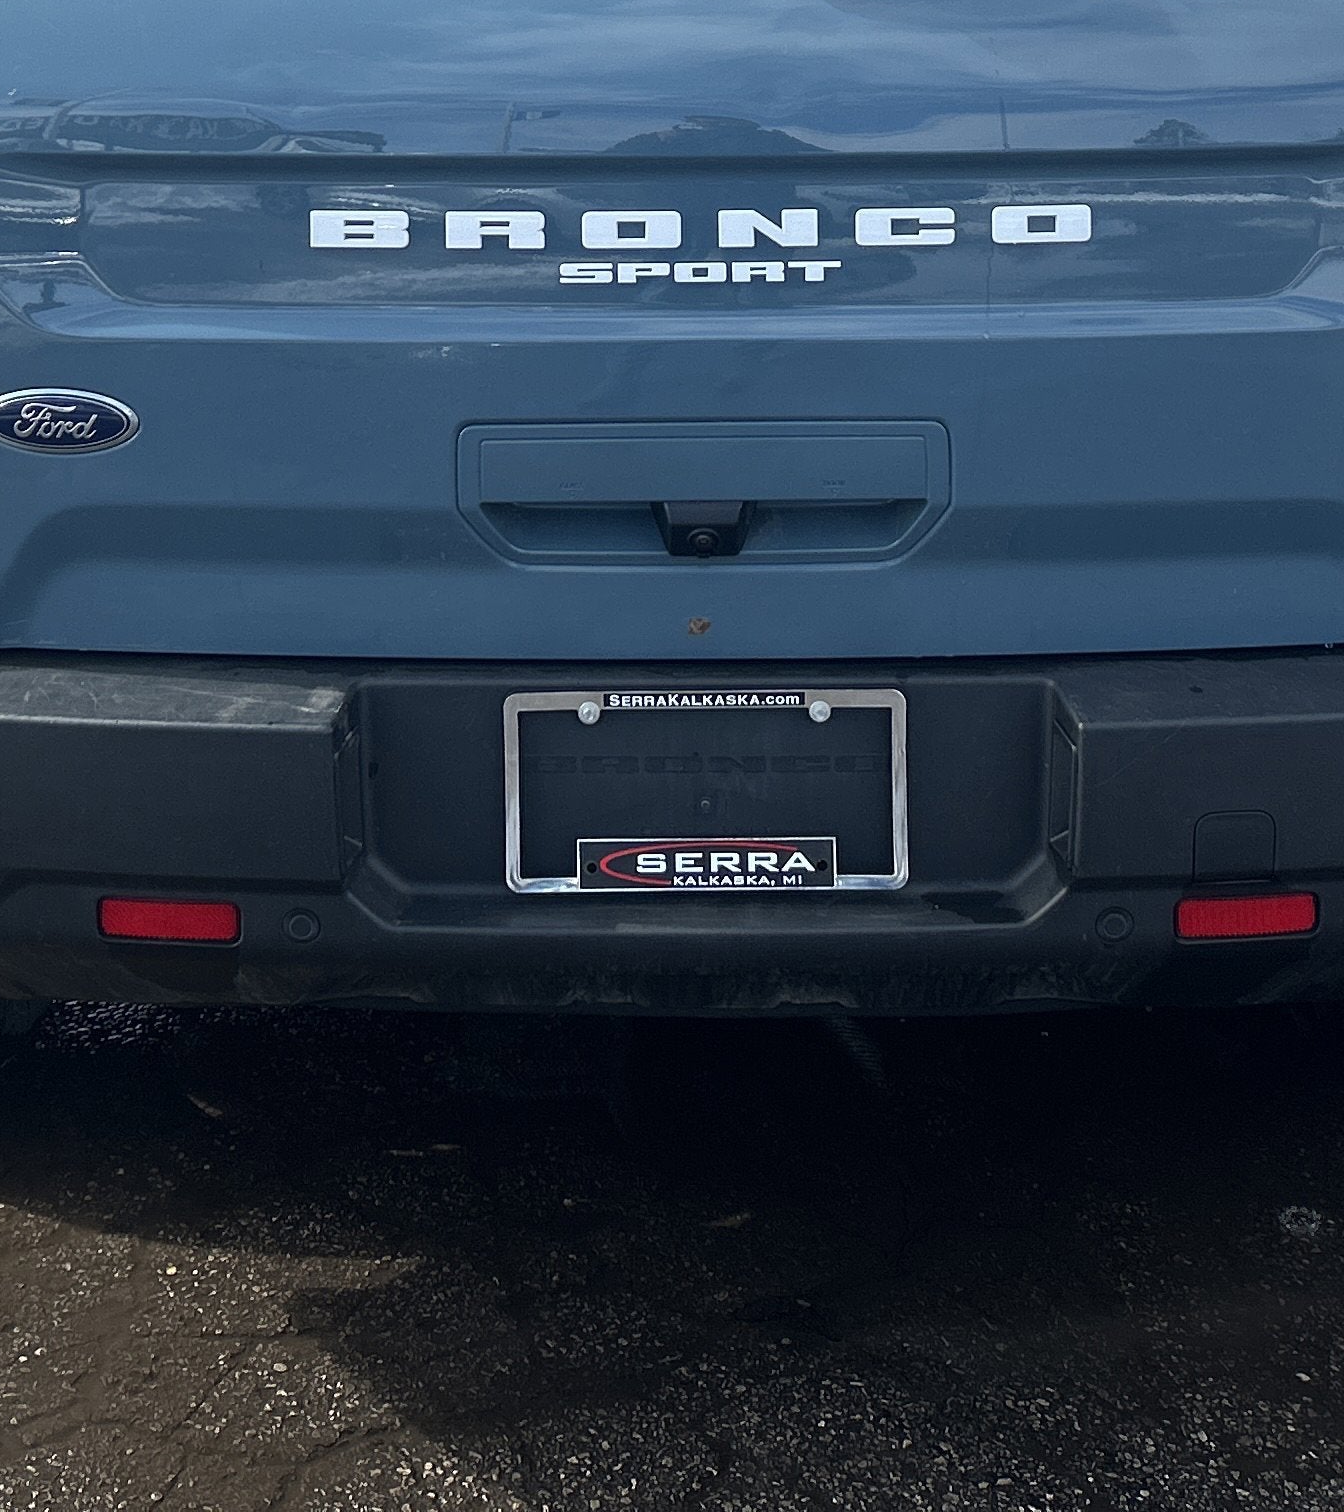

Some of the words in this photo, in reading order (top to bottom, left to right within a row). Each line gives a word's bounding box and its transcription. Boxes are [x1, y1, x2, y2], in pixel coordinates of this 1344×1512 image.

[309, 203, 1092, 250] BRONCO
[558, 259, 842, 284] SPORT
[13, 402, 98, 439] Ford
[636, 851, 816, 874] SERRA
[782, 874, 803, 886] MI
